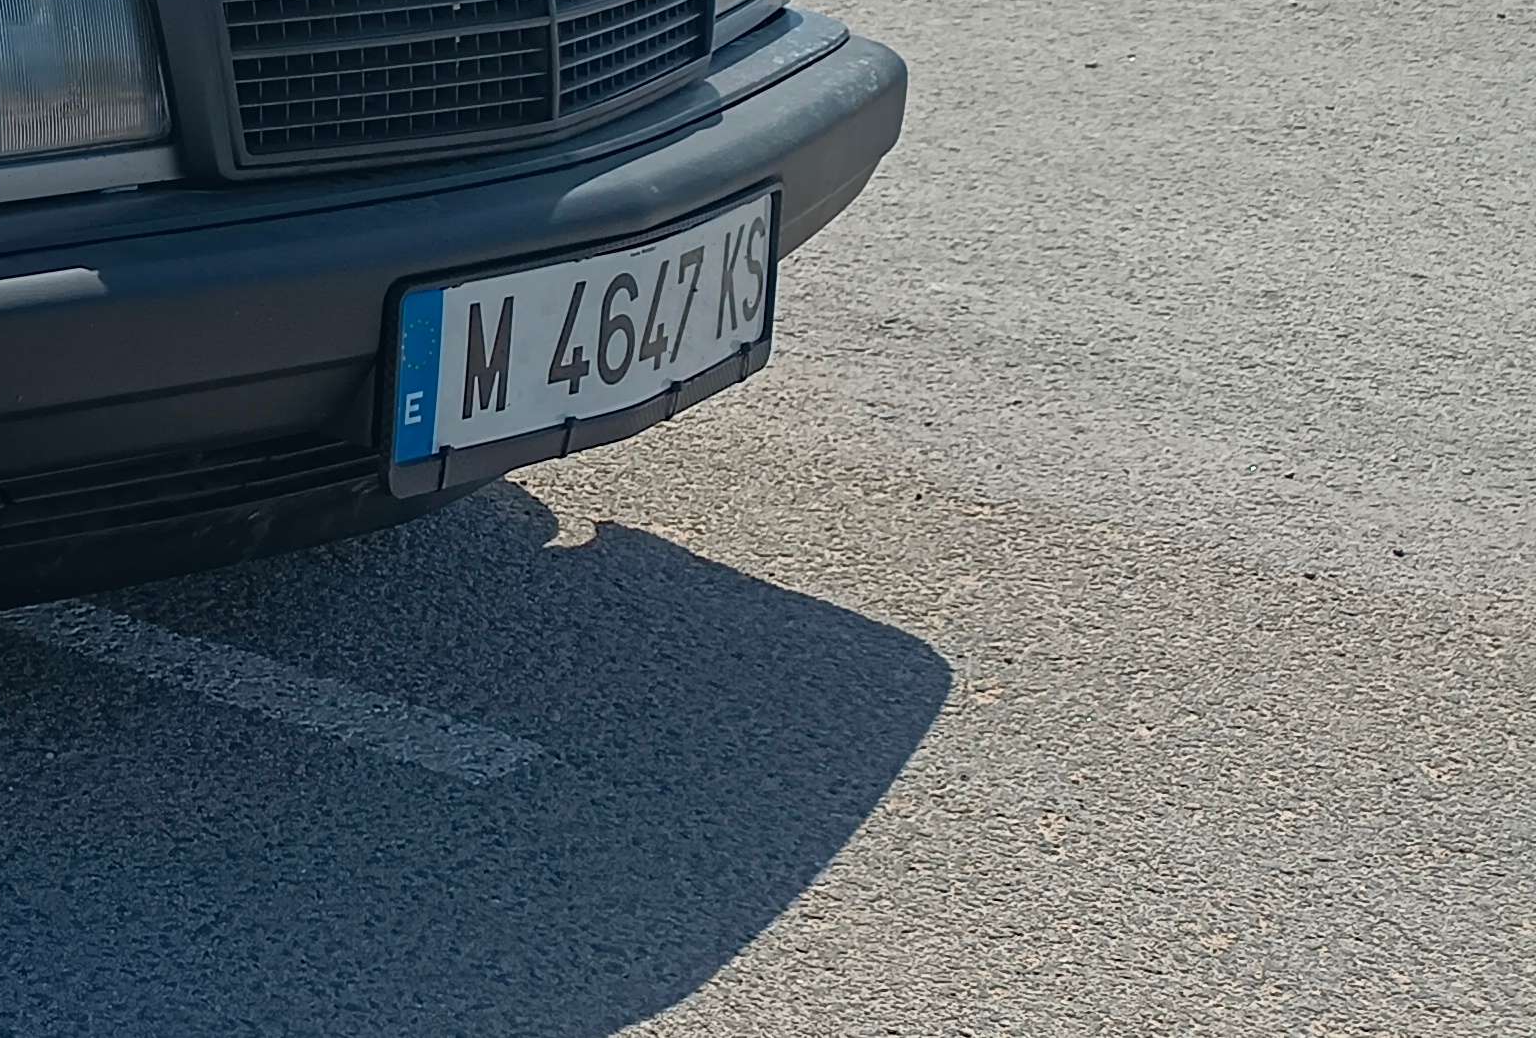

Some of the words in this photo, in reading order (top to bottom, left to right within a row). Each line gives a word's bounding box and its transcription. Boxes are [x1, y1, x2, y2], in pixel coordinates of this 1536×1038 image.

[462, 297, 514, 420] M
[547, 245, 705, 395] 4647
[716, 216, 765, 339] KS
[404, 391, 423, 425] E
